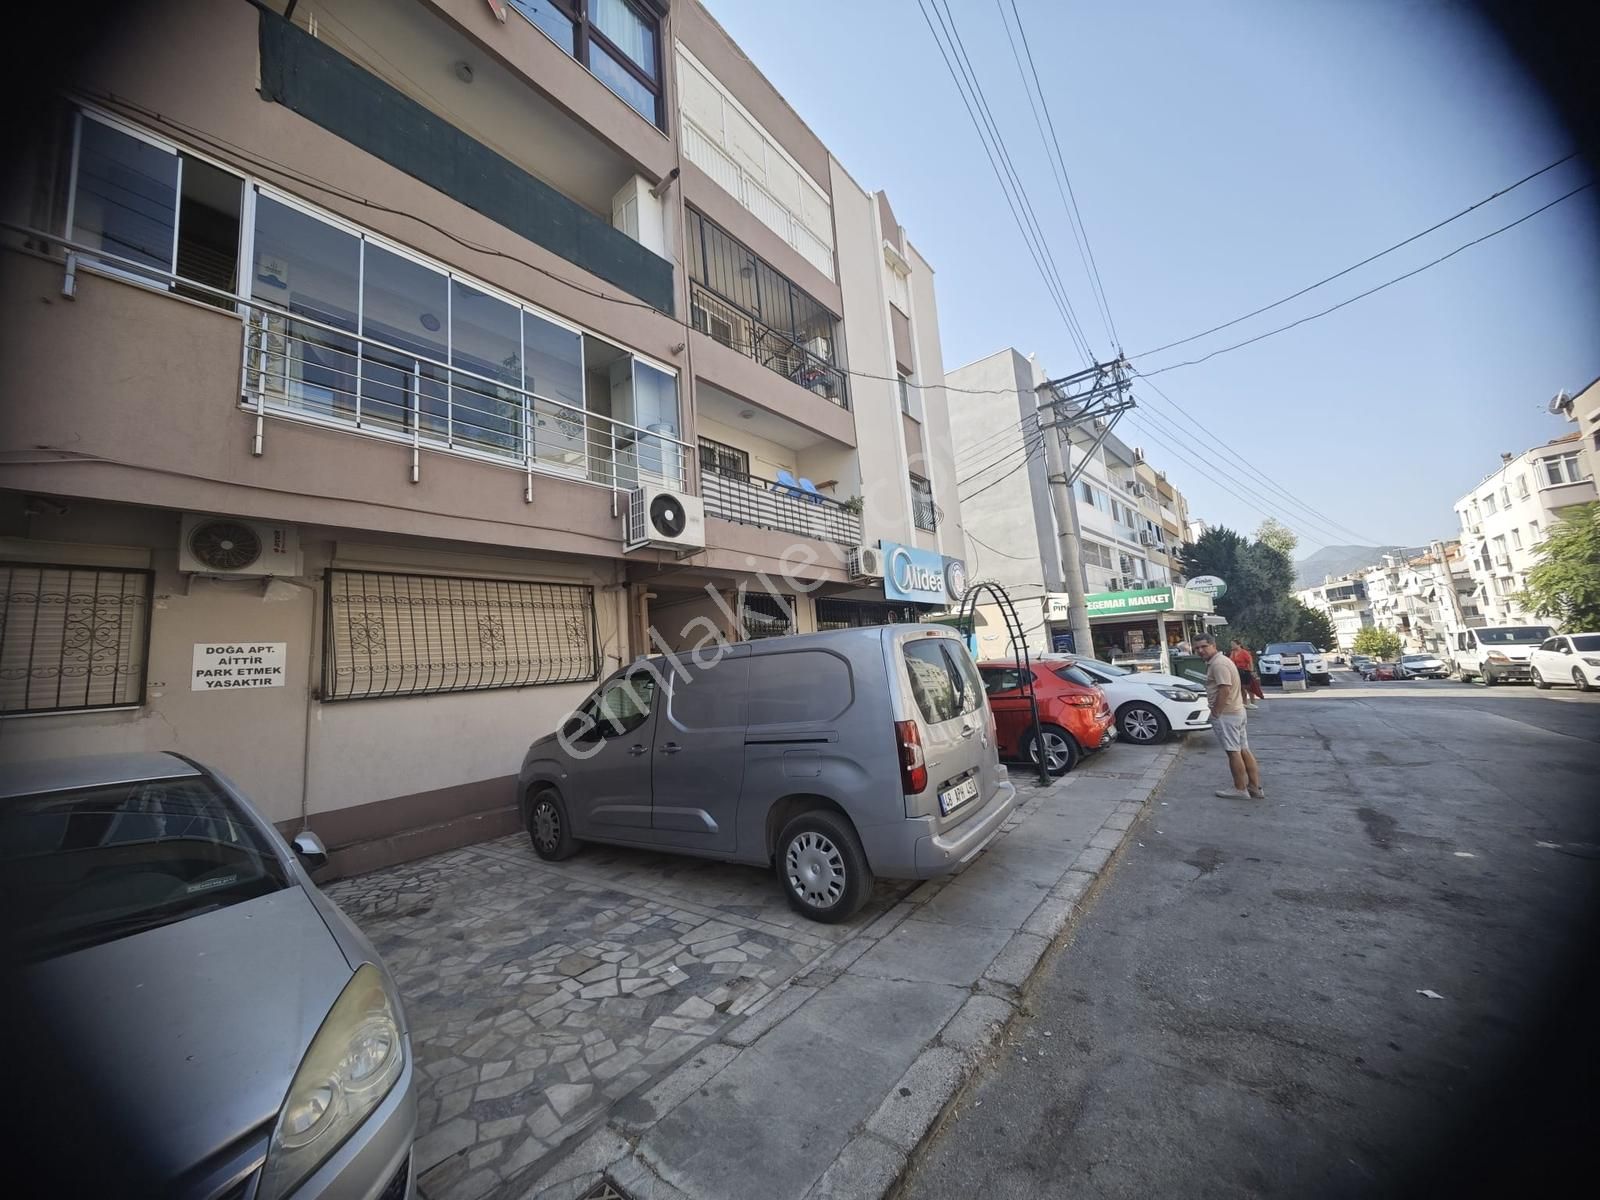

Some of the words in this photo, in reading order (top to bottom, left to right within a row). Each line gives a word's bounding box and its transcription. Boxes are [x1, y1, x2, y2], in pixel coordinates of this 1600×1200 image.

[891, 546, 944, 594] Midea
[1087, 598, 1126, 610] EGEMAR
[1128, 594, 1170, 607] MARKET
[206, 645, 244, 655] DOĞA
[248, 646, 275, 654] APT.
[218, 655, 263, 665] AİTTİR
[196, 668, 233, 677] PARK
[237, 666, 281, 676] ETMEK
[206, 678, 272, 688] YASAKTIR
